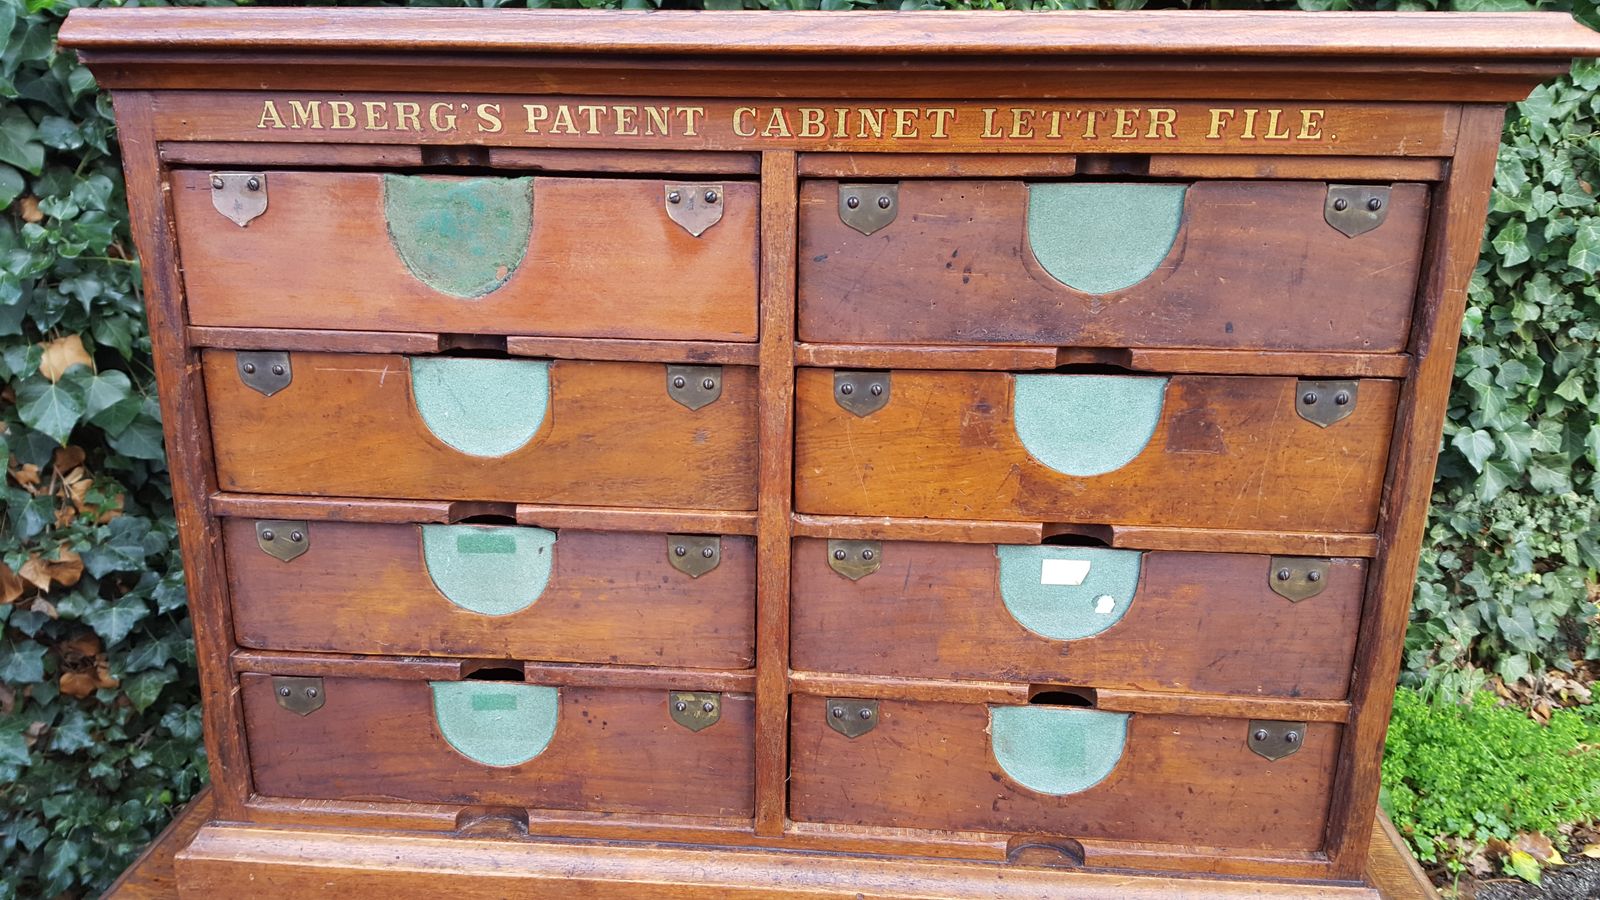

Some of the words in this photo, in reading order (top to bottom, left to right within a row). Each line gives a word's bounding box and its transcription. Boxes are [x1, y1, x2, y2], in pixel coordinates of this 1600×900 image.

[257, 99, 503, 133] AMBERG'S
[523, 103, 705, 136] PATENT
[732, 106, 957, 139] CABINET
[981, 107, 1178, 139] LETTER
[1206, 108, 1339, 140] FILE.
